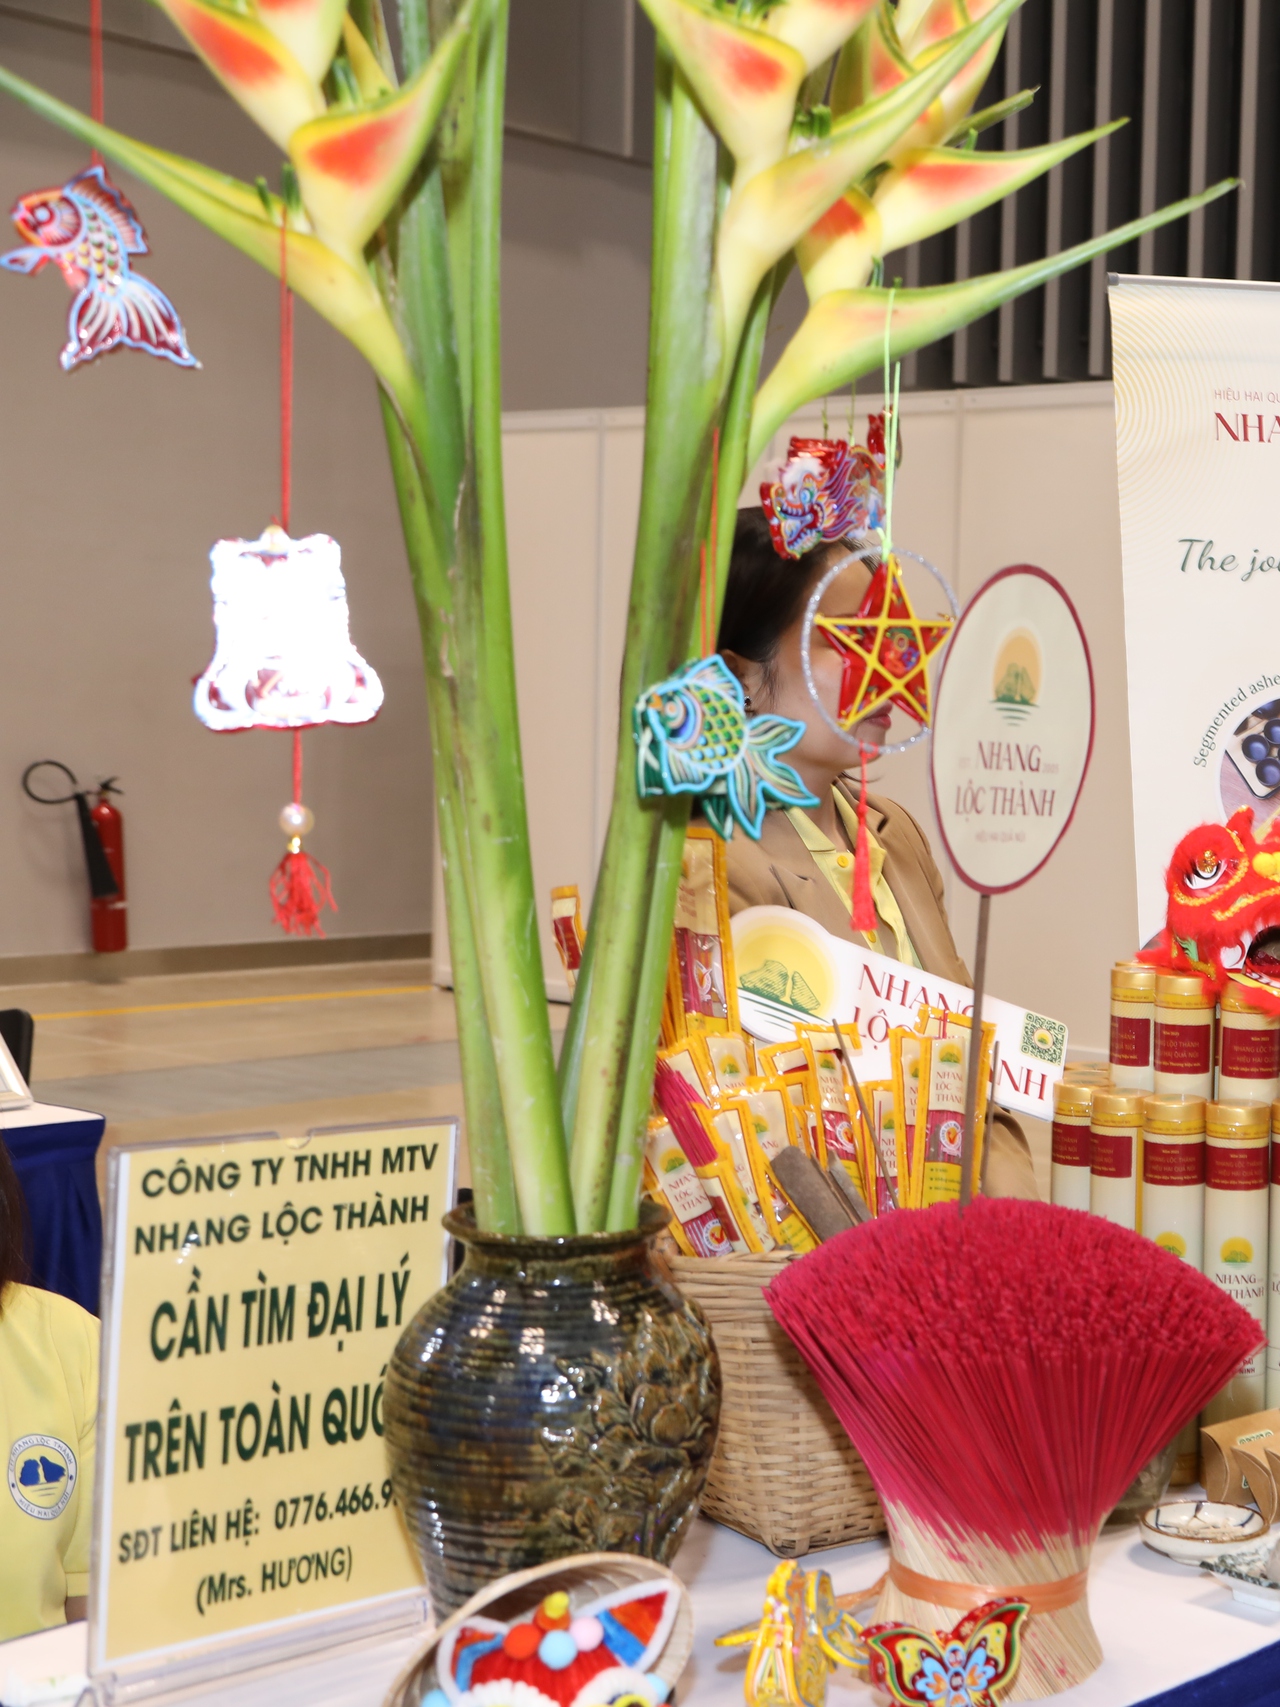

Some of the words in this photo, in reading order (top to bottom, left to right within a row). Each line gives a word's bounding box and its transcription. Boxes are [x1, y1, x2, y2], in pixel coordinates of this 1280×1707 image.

[1244, 391, 1263, 402] HAI
[1178, 538, 1239, 573] The
[977, 740, 1042, 773] NHANG
[1193, 688, 1248, 768] Segmented
[954, 779, 987, 823] LỘC
[989, 780, 1056, 818] THÀNH
[141, 1158, 241, 1198] CÔNG
[252, 1157, 284, 1187] TY
[294, 1149, 371, 1183] TNHH
[381, 1143, 438, 1174] MTV
[134, 1214, 250, 1255] NHANG
[261, 1201, 323, 1246] LỘC
[333, 1191, 429, 1231] THÀNH
[150, 1265, 230, 1363] CẦN
[241, 1269, 297, 1349] TÌM
[307, 1275, 366, 1352] ĐẠI
[374, 1251, 411, 1329] LÝ
[1215, 1273, 1257, 1285] NHANG
[125, 1397, 207, 1483] TRÊN
[219, 1379, 311, 1466] TOÀN
[118, 1525, 163, 1564] SĐT
[170, 1508, 217, 1553] LIÊN
[225, 1498, 260, 1547] HỆ:
[196, 1571, 253, 1617] (Mrs.
[261, 1545, 353, 1594] HƯƠNG)
